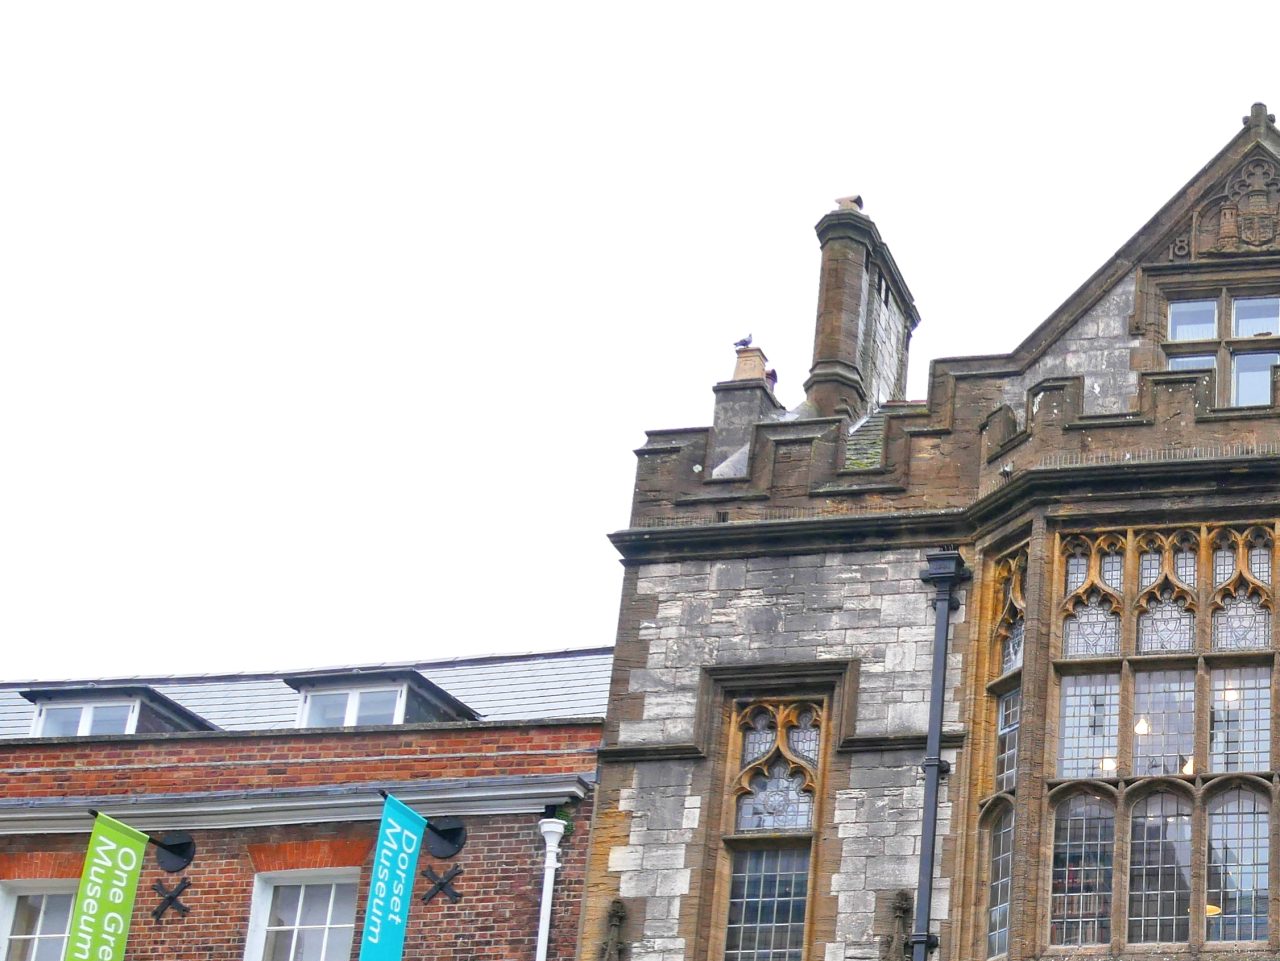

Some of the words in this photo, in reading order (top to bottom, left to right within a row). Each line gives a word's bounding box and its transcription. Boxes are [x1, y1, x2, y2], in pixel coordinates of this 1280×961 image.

[1168, 237, 1189, 262] 18
[74, 835, 117, 960] Museum
[109, 847, 136, 903] One
[368, 817, 402, 944] Museum
[388, 829, 417, 925] Dorset
